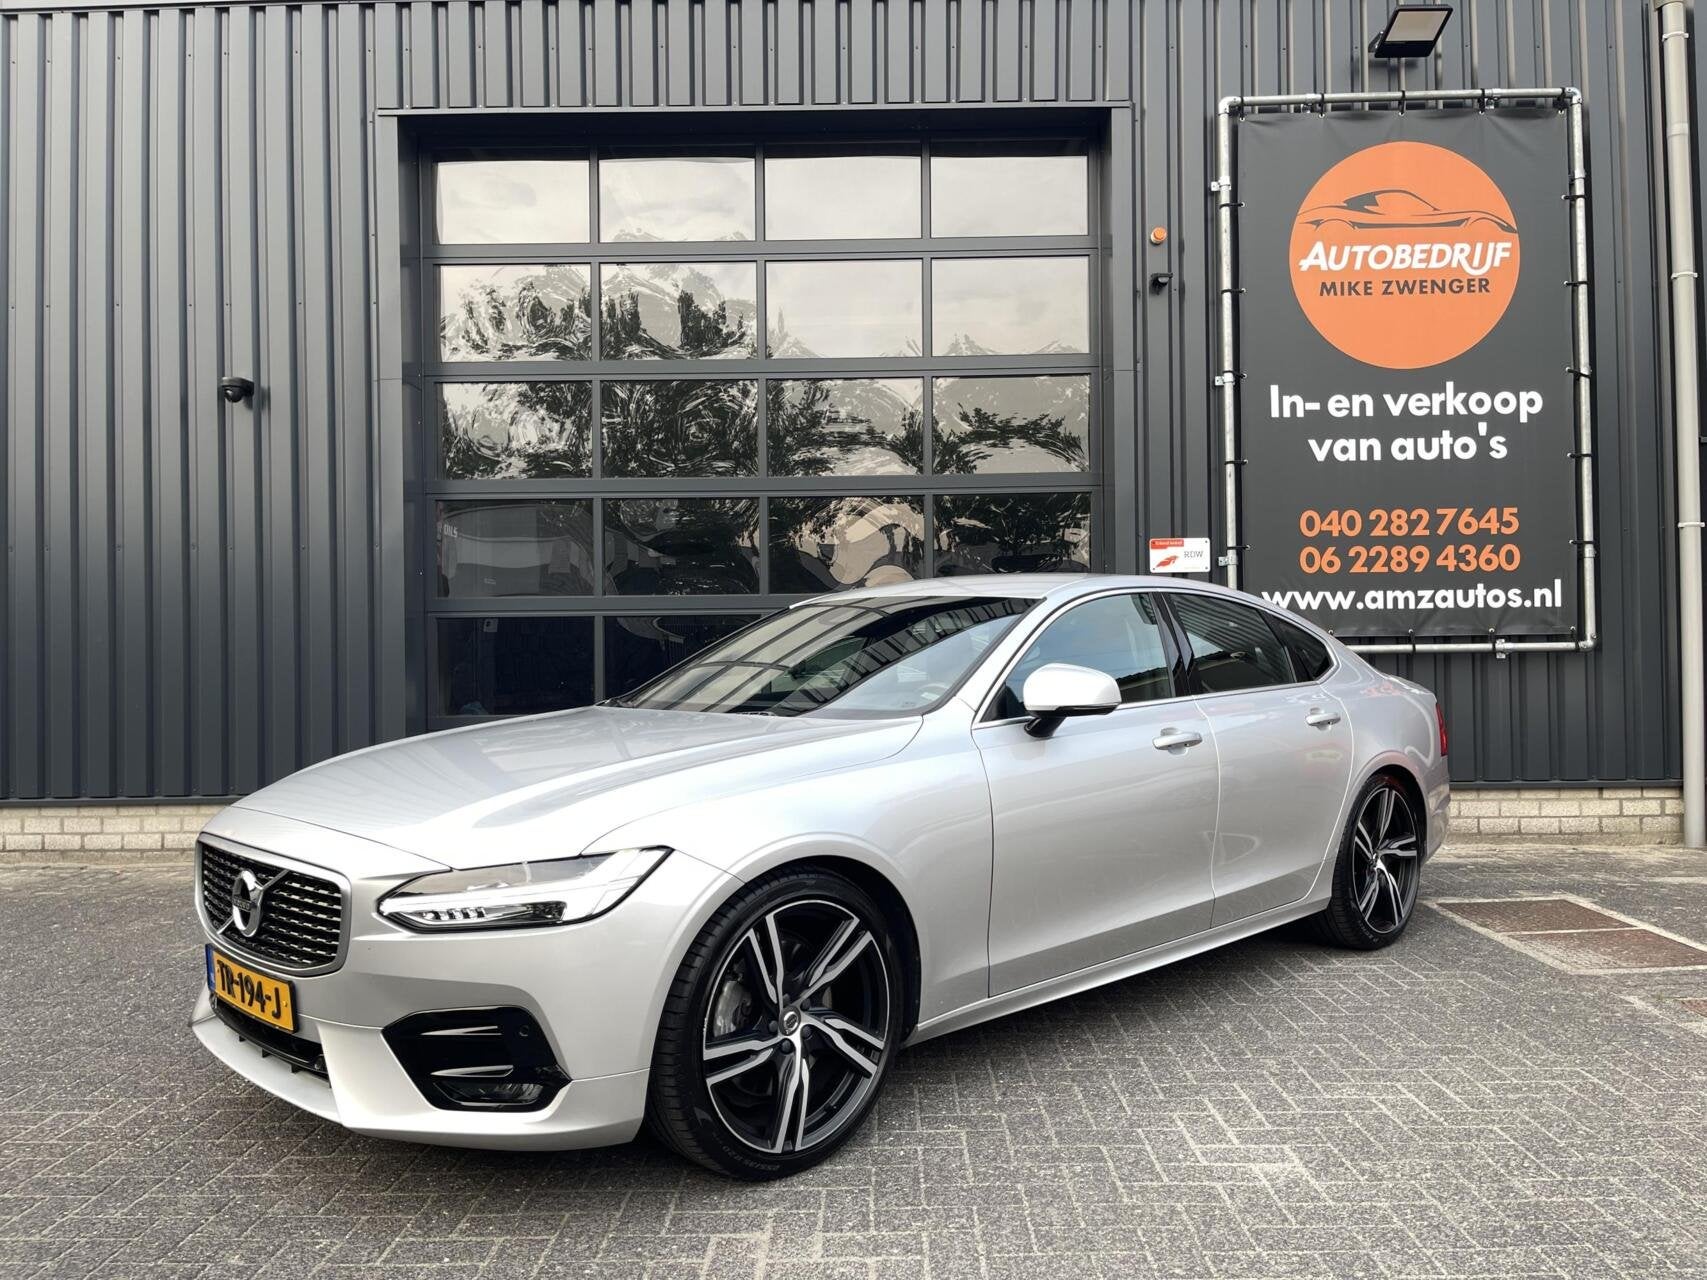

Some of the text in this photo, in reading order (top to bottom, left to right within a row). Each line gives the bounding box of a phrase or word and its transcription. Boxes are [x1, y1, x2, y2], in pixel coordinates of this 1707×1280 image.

[1299, 240, 1512, 276] AUTOBEDRIJF
[1319, 278, 1491, 297] MIKE ZWENGER
[1269, 381, 1544, 423] In- en verkoop
[1307, 422, 1508, 462] van auto's
[1299, 506, 1520, 538] 040 282 7645
[1299, 543, 1521, 574] 06 2289 4360
[1261, 578, 1562, 610] www.amzautos.nl
[216, 959, 283, 1020] TR-194-J
